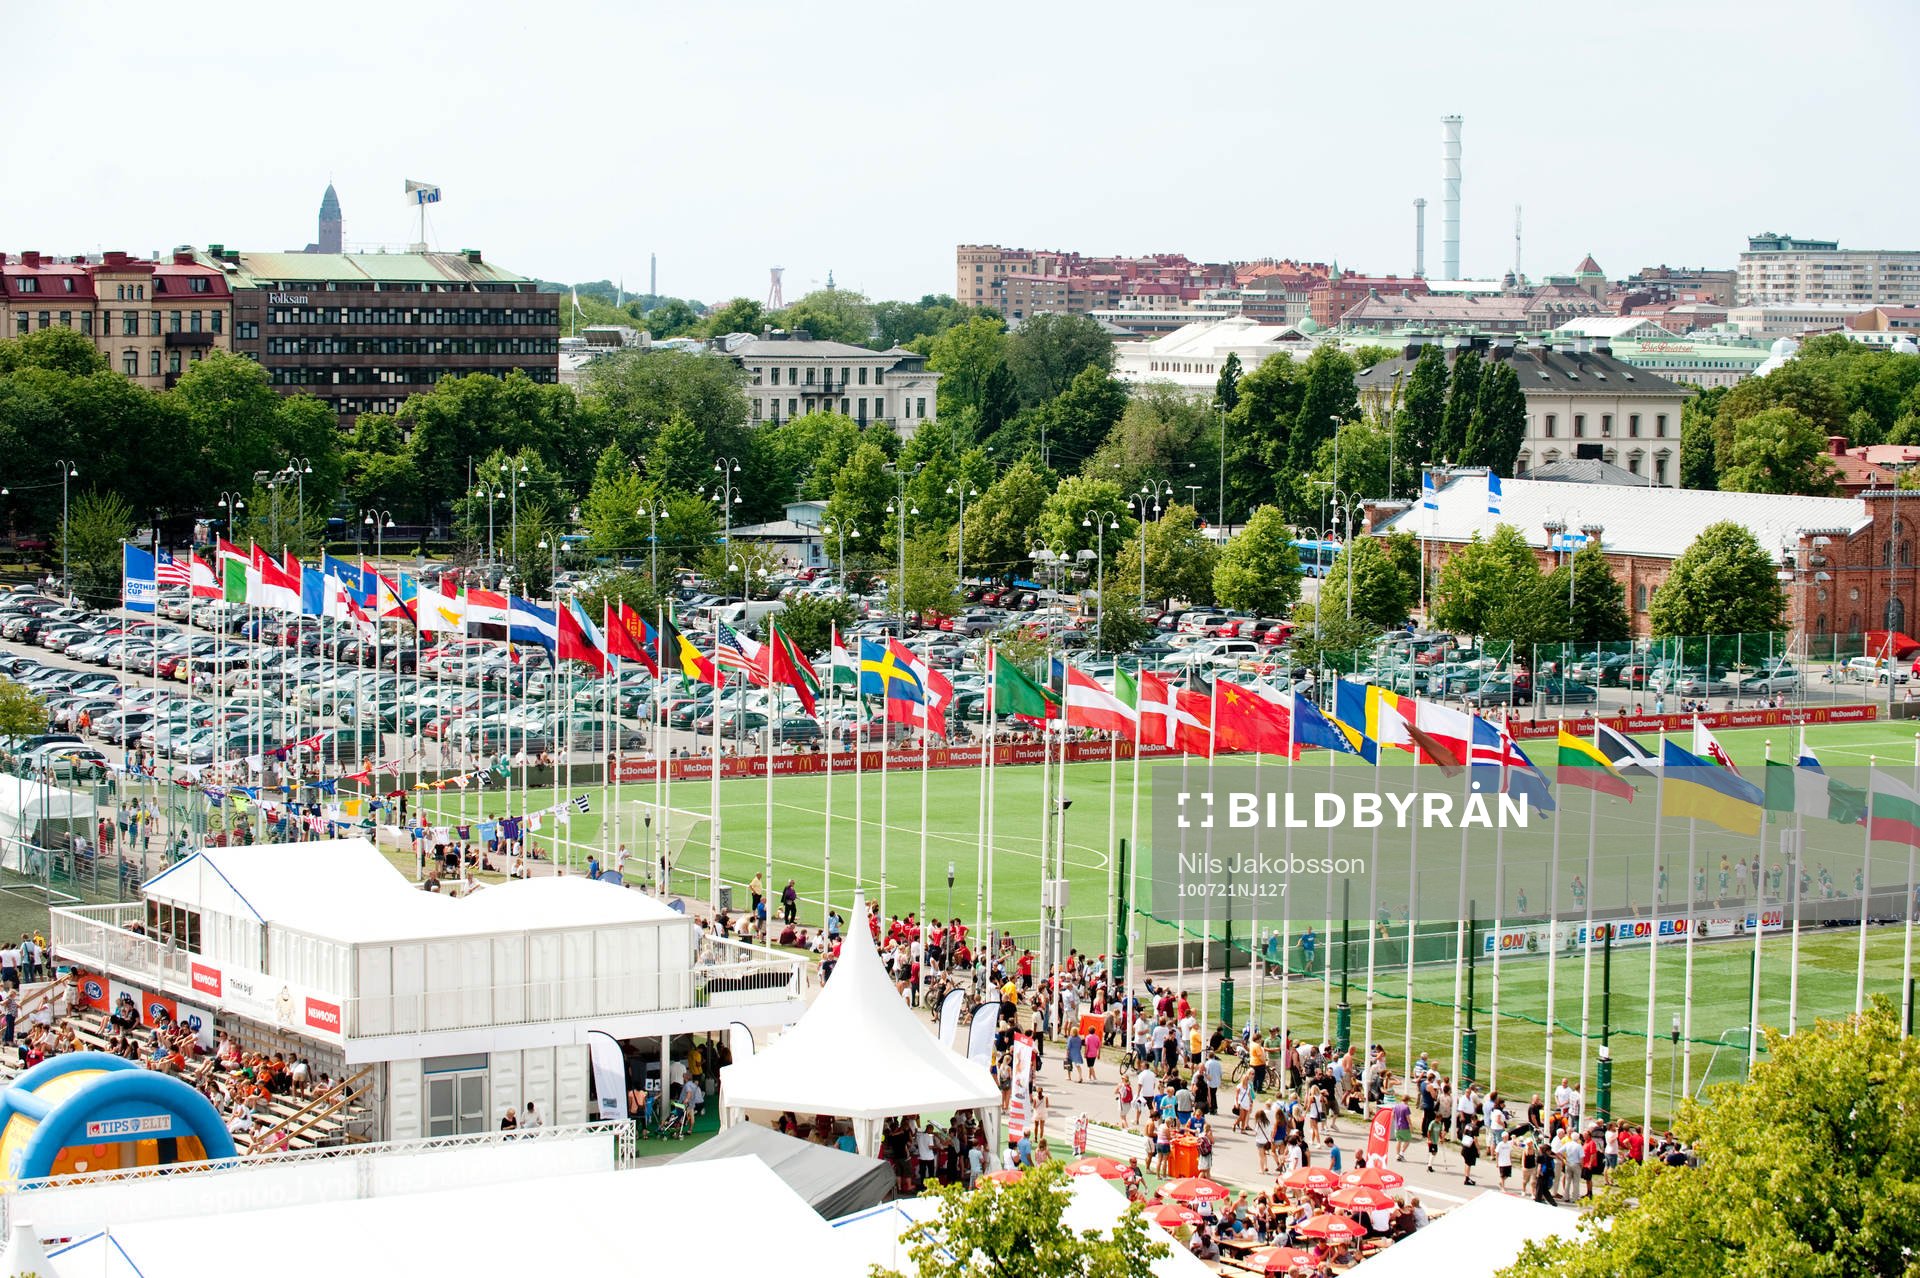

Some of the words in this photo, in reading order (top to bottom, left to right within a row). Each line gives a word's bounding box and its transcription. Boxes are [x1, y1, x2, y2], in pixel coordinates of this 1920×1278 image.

[269, 292, 309, 304] Folksam
[230, 978, 243, 991] Think
[101, 1120, 129, 1134] TIPS
[142, 1116, 170, 1130] ELIT
